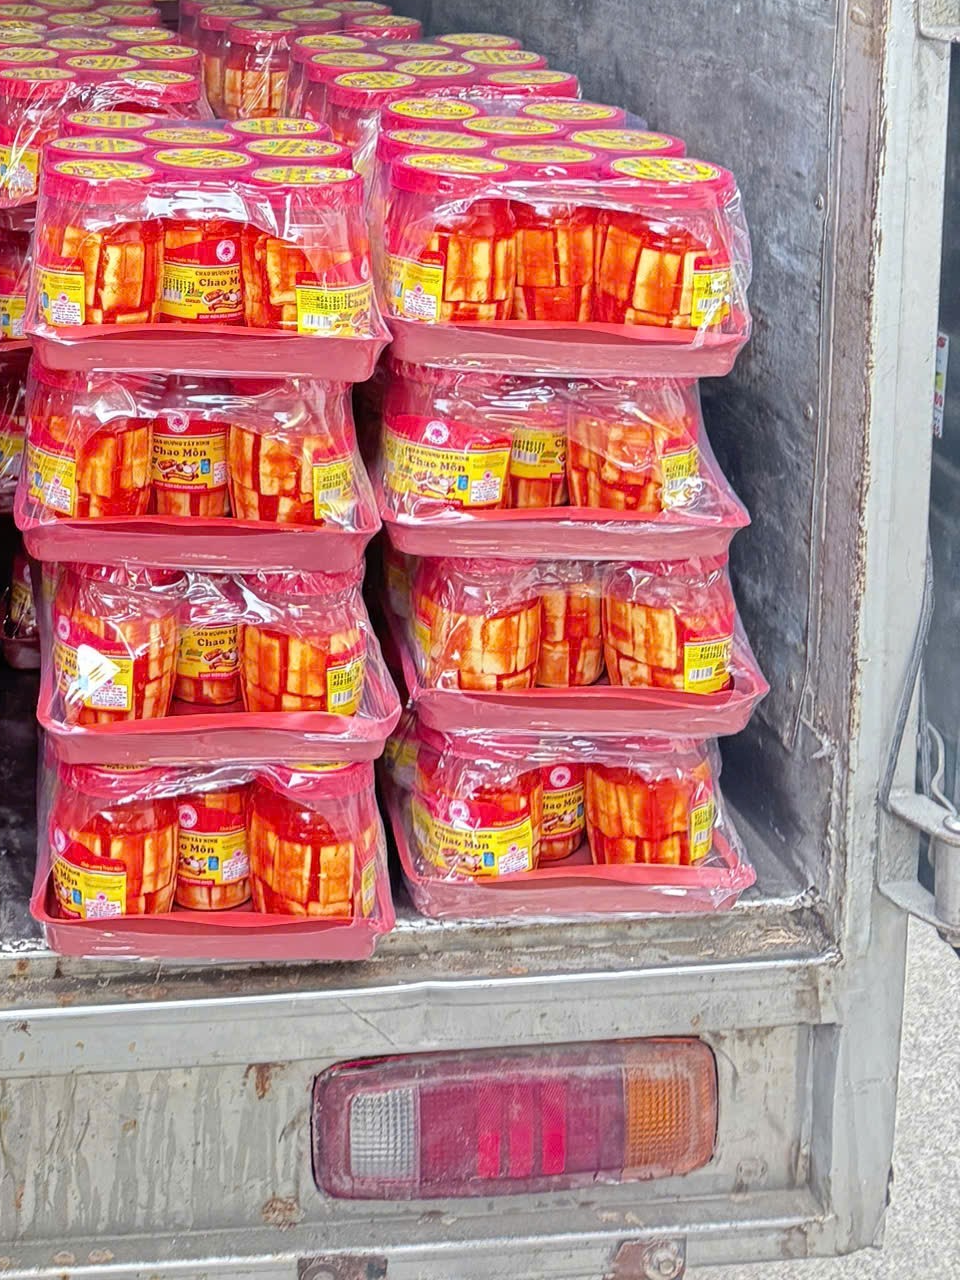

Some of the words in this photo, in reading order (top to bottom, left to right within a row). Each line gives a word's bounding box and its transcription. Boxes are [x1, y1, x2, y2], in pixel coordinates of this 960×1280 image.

[199, 278, 227, 287] Chao
[153, 445, 179, 456] Chao
[183, 448, 206, 457] Môn
[440, 461, 465, 472] Môn
[197, 638, 225, 647] Chao
[190, 843, 214, 854] Môn
